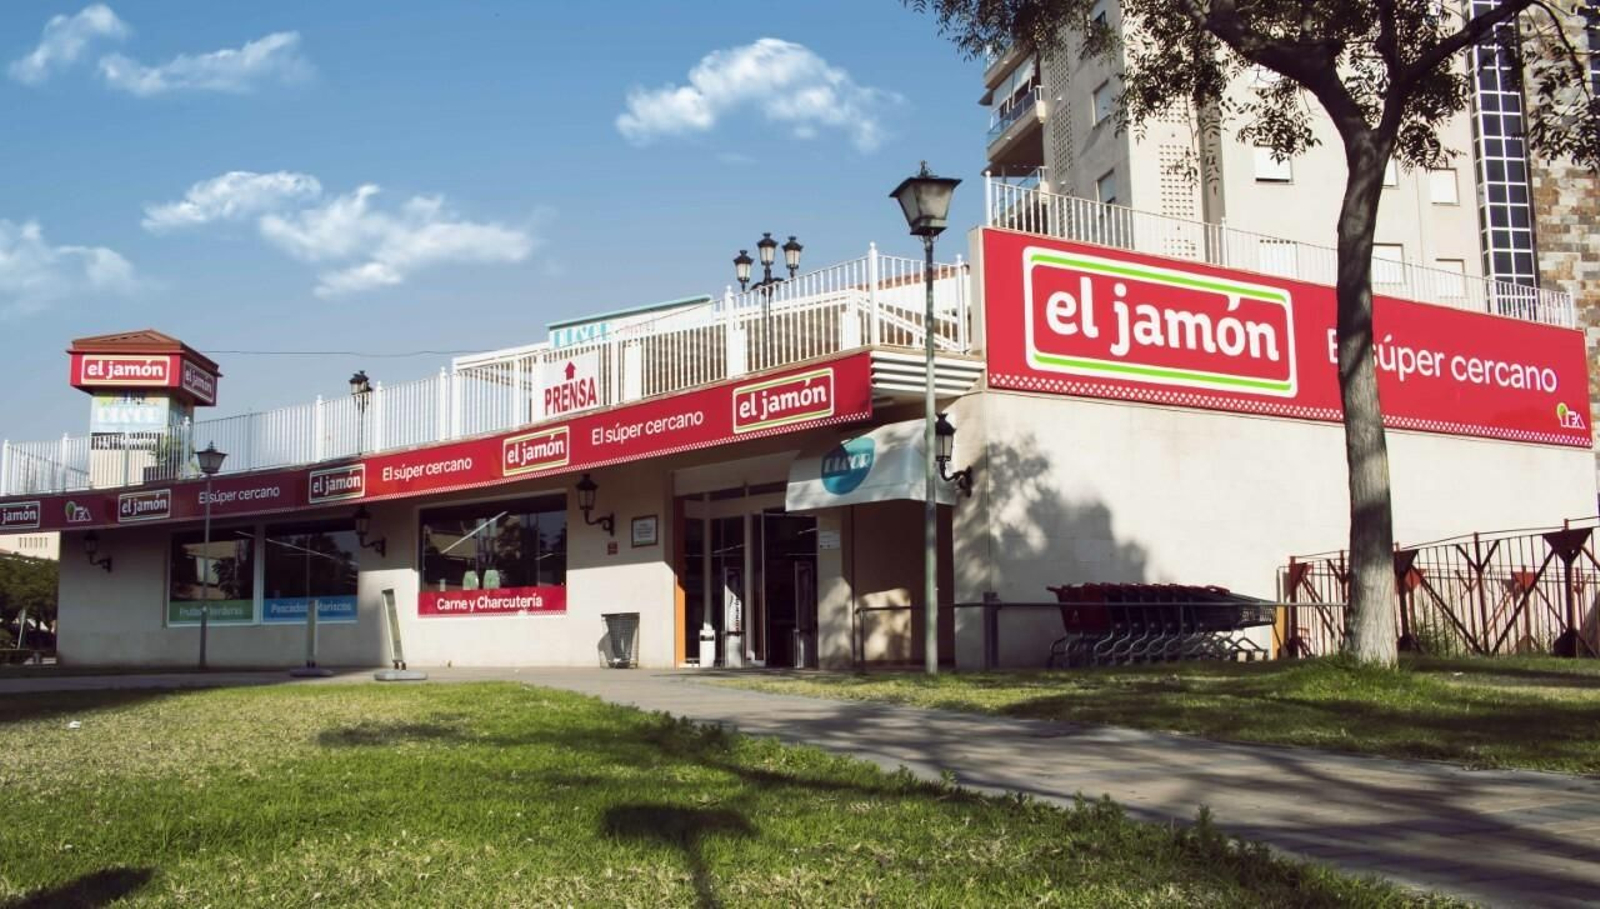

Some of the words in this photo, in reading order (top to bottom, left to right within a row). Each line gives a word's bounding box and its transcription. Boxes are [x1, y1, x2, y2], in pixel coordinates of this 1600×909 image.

[1046, 276, 1099, 338] el
[1110, 282, 1280, 361] jamón
[87, 361, 104, 376] el
[106, 359, 164, 380] jamón
[1450, 355, 1558, 392] cercano
[545, 376, 597, 416] PRENSA
[739, 393, 758, 419] el
[760, 379, 827, 421] jamón
[592, 426, 604, 446] El
[605, 422, 645, 444] súper
[645, 411, 704, 435] cercano
[507, 444, 520, 465] el
[521, 434, 565, 467] jamón
[313, 477, 324, 493] el
[325, 470, 361, 497] jamón
[382, 466, 394, 481] El
[394, 463, 425, 483] súper
[426, 458, 473, 478] cercano
[122, 499, 133, 513] el
[133, 494, 168, 509] jamón
[209, 490, 237, 506] súper
[238, 486, 280, 500] cercano
[1, 505, 37, 525] jamón
[437, 598, 469, 611] Carne
[469, 600, 476, 612] y
[477, 593, 543, 609] Charcutería
